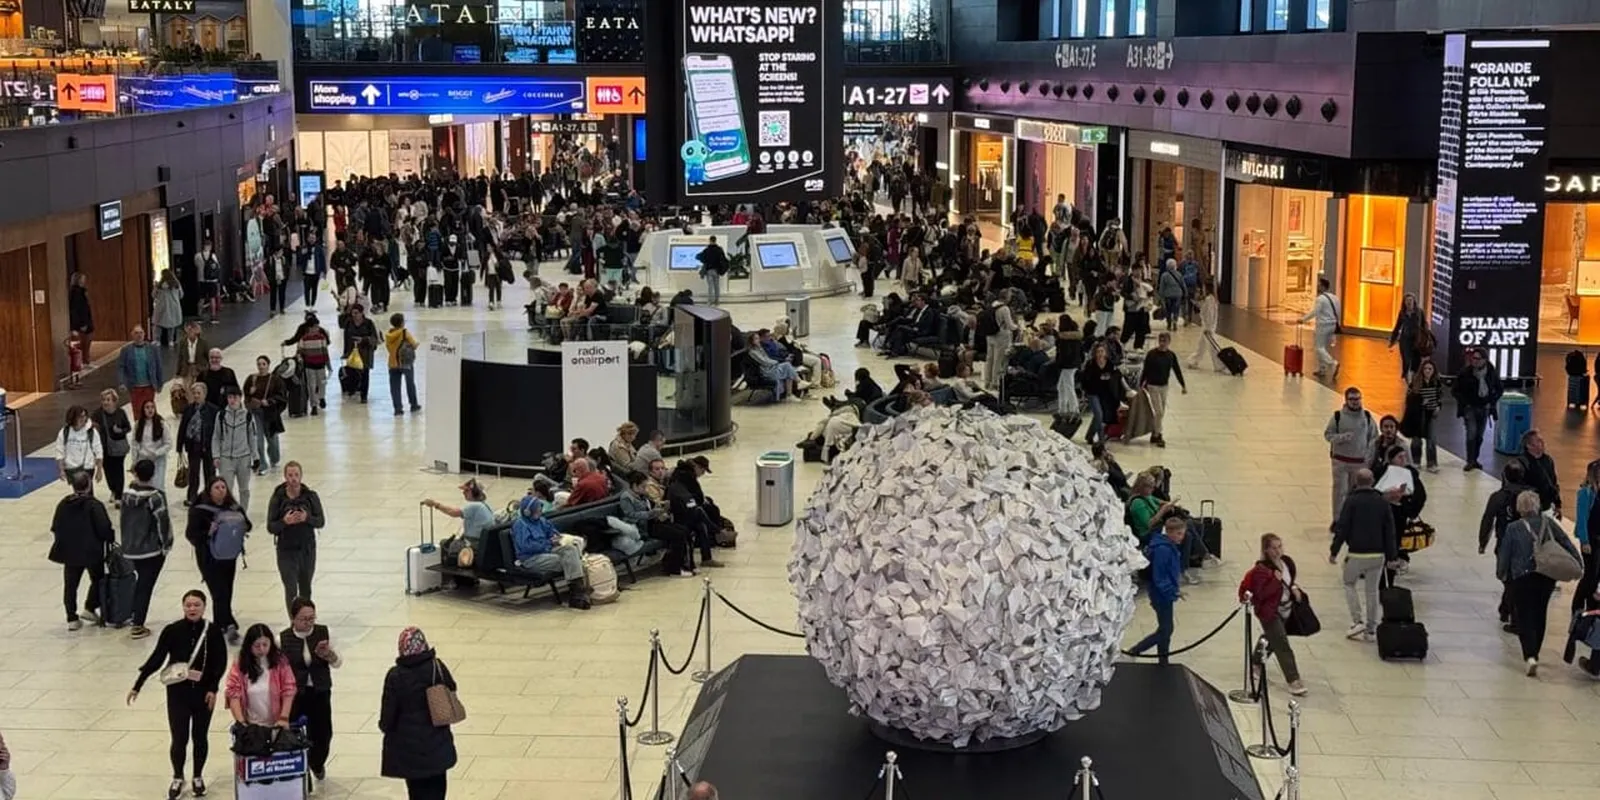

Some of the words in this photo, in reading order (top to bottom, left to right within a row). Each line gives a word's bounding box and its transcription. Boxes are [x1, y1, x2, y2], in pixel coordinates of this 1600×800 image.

[130, 0, 193, 10] EATALY
[690, 7, 761, 25] WHAT'S
[765, 7, 817, 24] NEW?
[690, 26, 795, 43] WHATSAPP!
[759, 53, 780, 62] STOP
[1127, 44, 1156, 68] A31-83
[759, 63, 769, 72] AT
[772, 63, 787, 72] THE
[1469, 76, 1510, 88] FOLLA
[314, 84, 339, 94] More
[314, 94, 357, 106] shopping
[848, 86, 907, 105] A1-27
[1241, 159, 1285, 180] BVLGARI
[1460, 317, 1529, 330] PILLARS
[1459, 331, 1487, 345] OF
[1488, 331, 1530, 345] ART
[578, 346, 606, 355] radio
[571, 355, 620, 366] onairport
[266, 765, 273, 773] di
[274, 764, 295, 773] Roma
